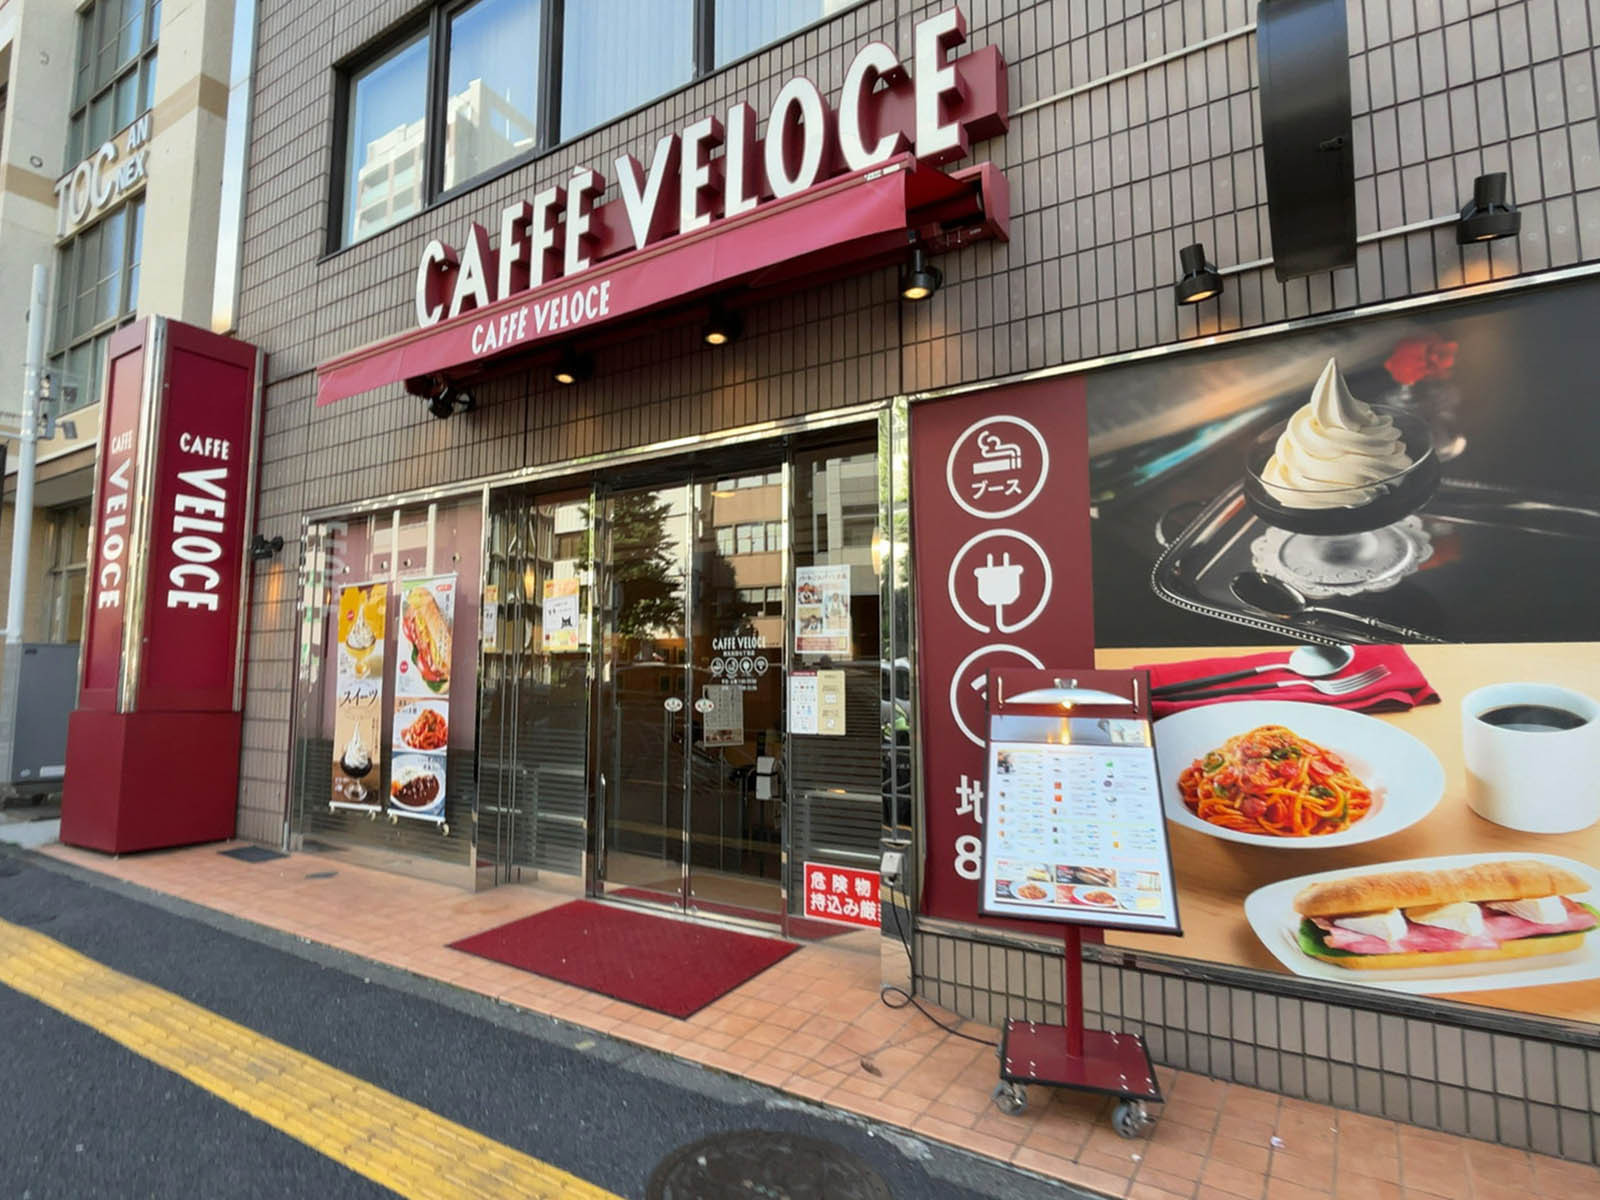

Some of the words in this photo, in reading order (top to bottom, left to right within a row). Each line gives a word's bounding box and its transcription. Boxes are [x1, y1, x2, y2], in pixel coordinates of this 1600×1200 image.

[127, 114, 150, 151] AN
[614, 6, 960, 250] VELOCE
[54, 142, 117, 237] TOC
[116, 150, 149, 192] NEX
[534, 280, 610, 334] VELOCE
[971, 479, 1022, 500] ブース
[98, 458, 132, 609] VELOCE
[167, 468, 228, 611] VELOCE
[340, 687, 378, 707] スイーツ
[811, 871, 881, 899] 危険物
[810, 892, 882, 922] 持込み厳
